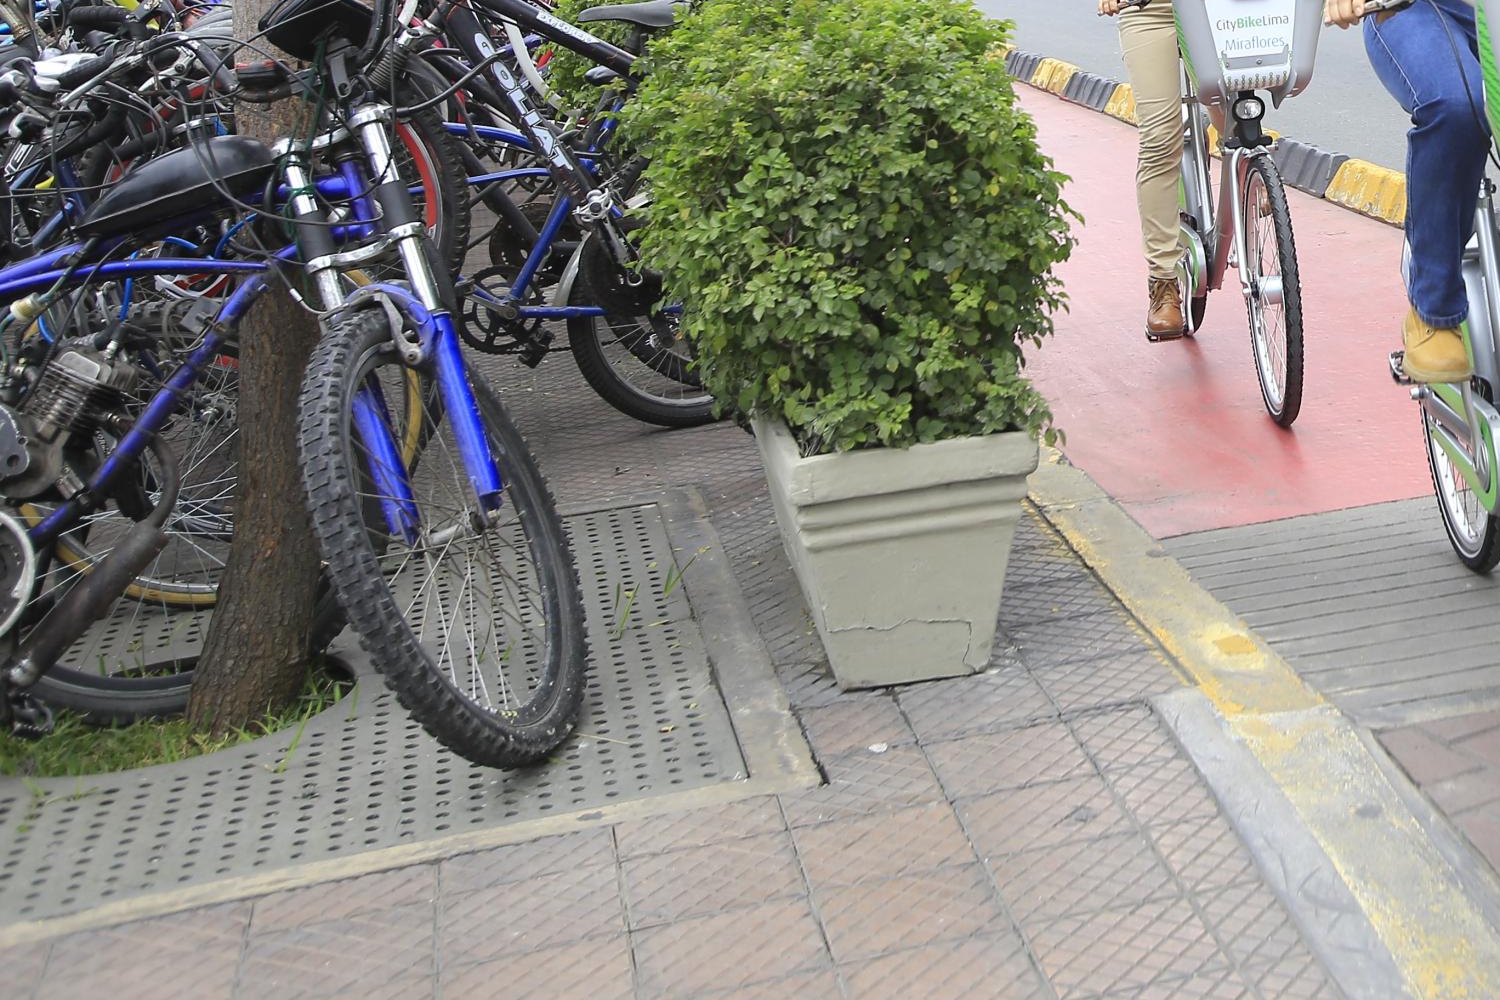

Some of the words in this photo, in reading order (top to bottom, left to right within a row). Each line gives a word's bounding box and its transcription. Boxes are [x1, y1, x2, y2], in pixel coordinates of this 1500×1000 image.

[1216, 14, 1289, 33] CityBikeLima
[1225, 36, 1285, 52] Miraflores
[474, 32, 574, 171] GOLIAT
